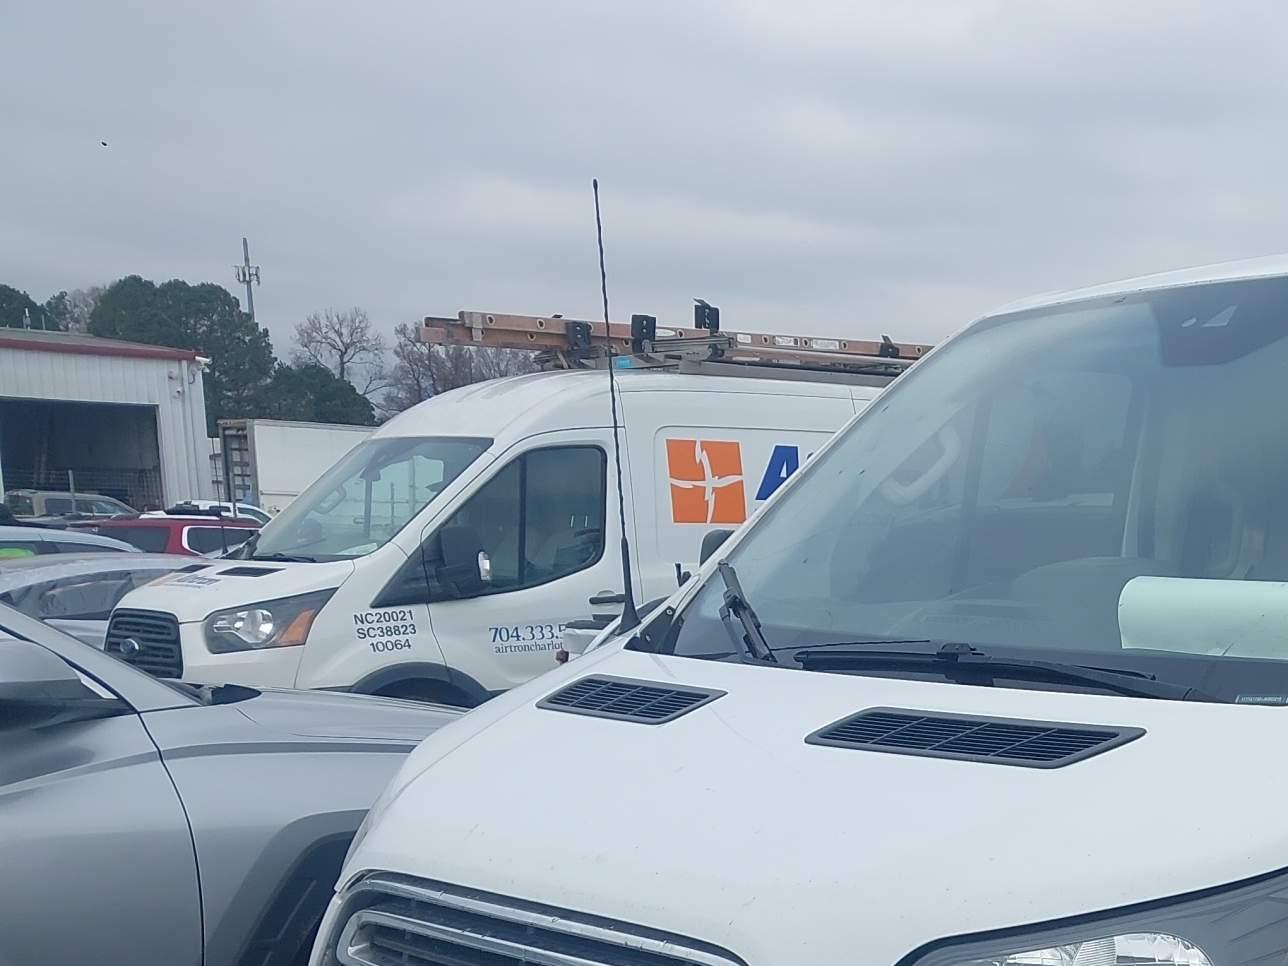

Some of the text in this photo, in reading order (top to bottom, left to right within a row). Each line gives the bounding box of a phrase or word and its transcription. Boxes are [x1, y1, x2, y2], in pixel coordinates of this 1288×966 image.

[353, 610, 415, 625] NC20021
[356, 624, 417, 640] SC38823
[370, 639, 412, 653] 10064
